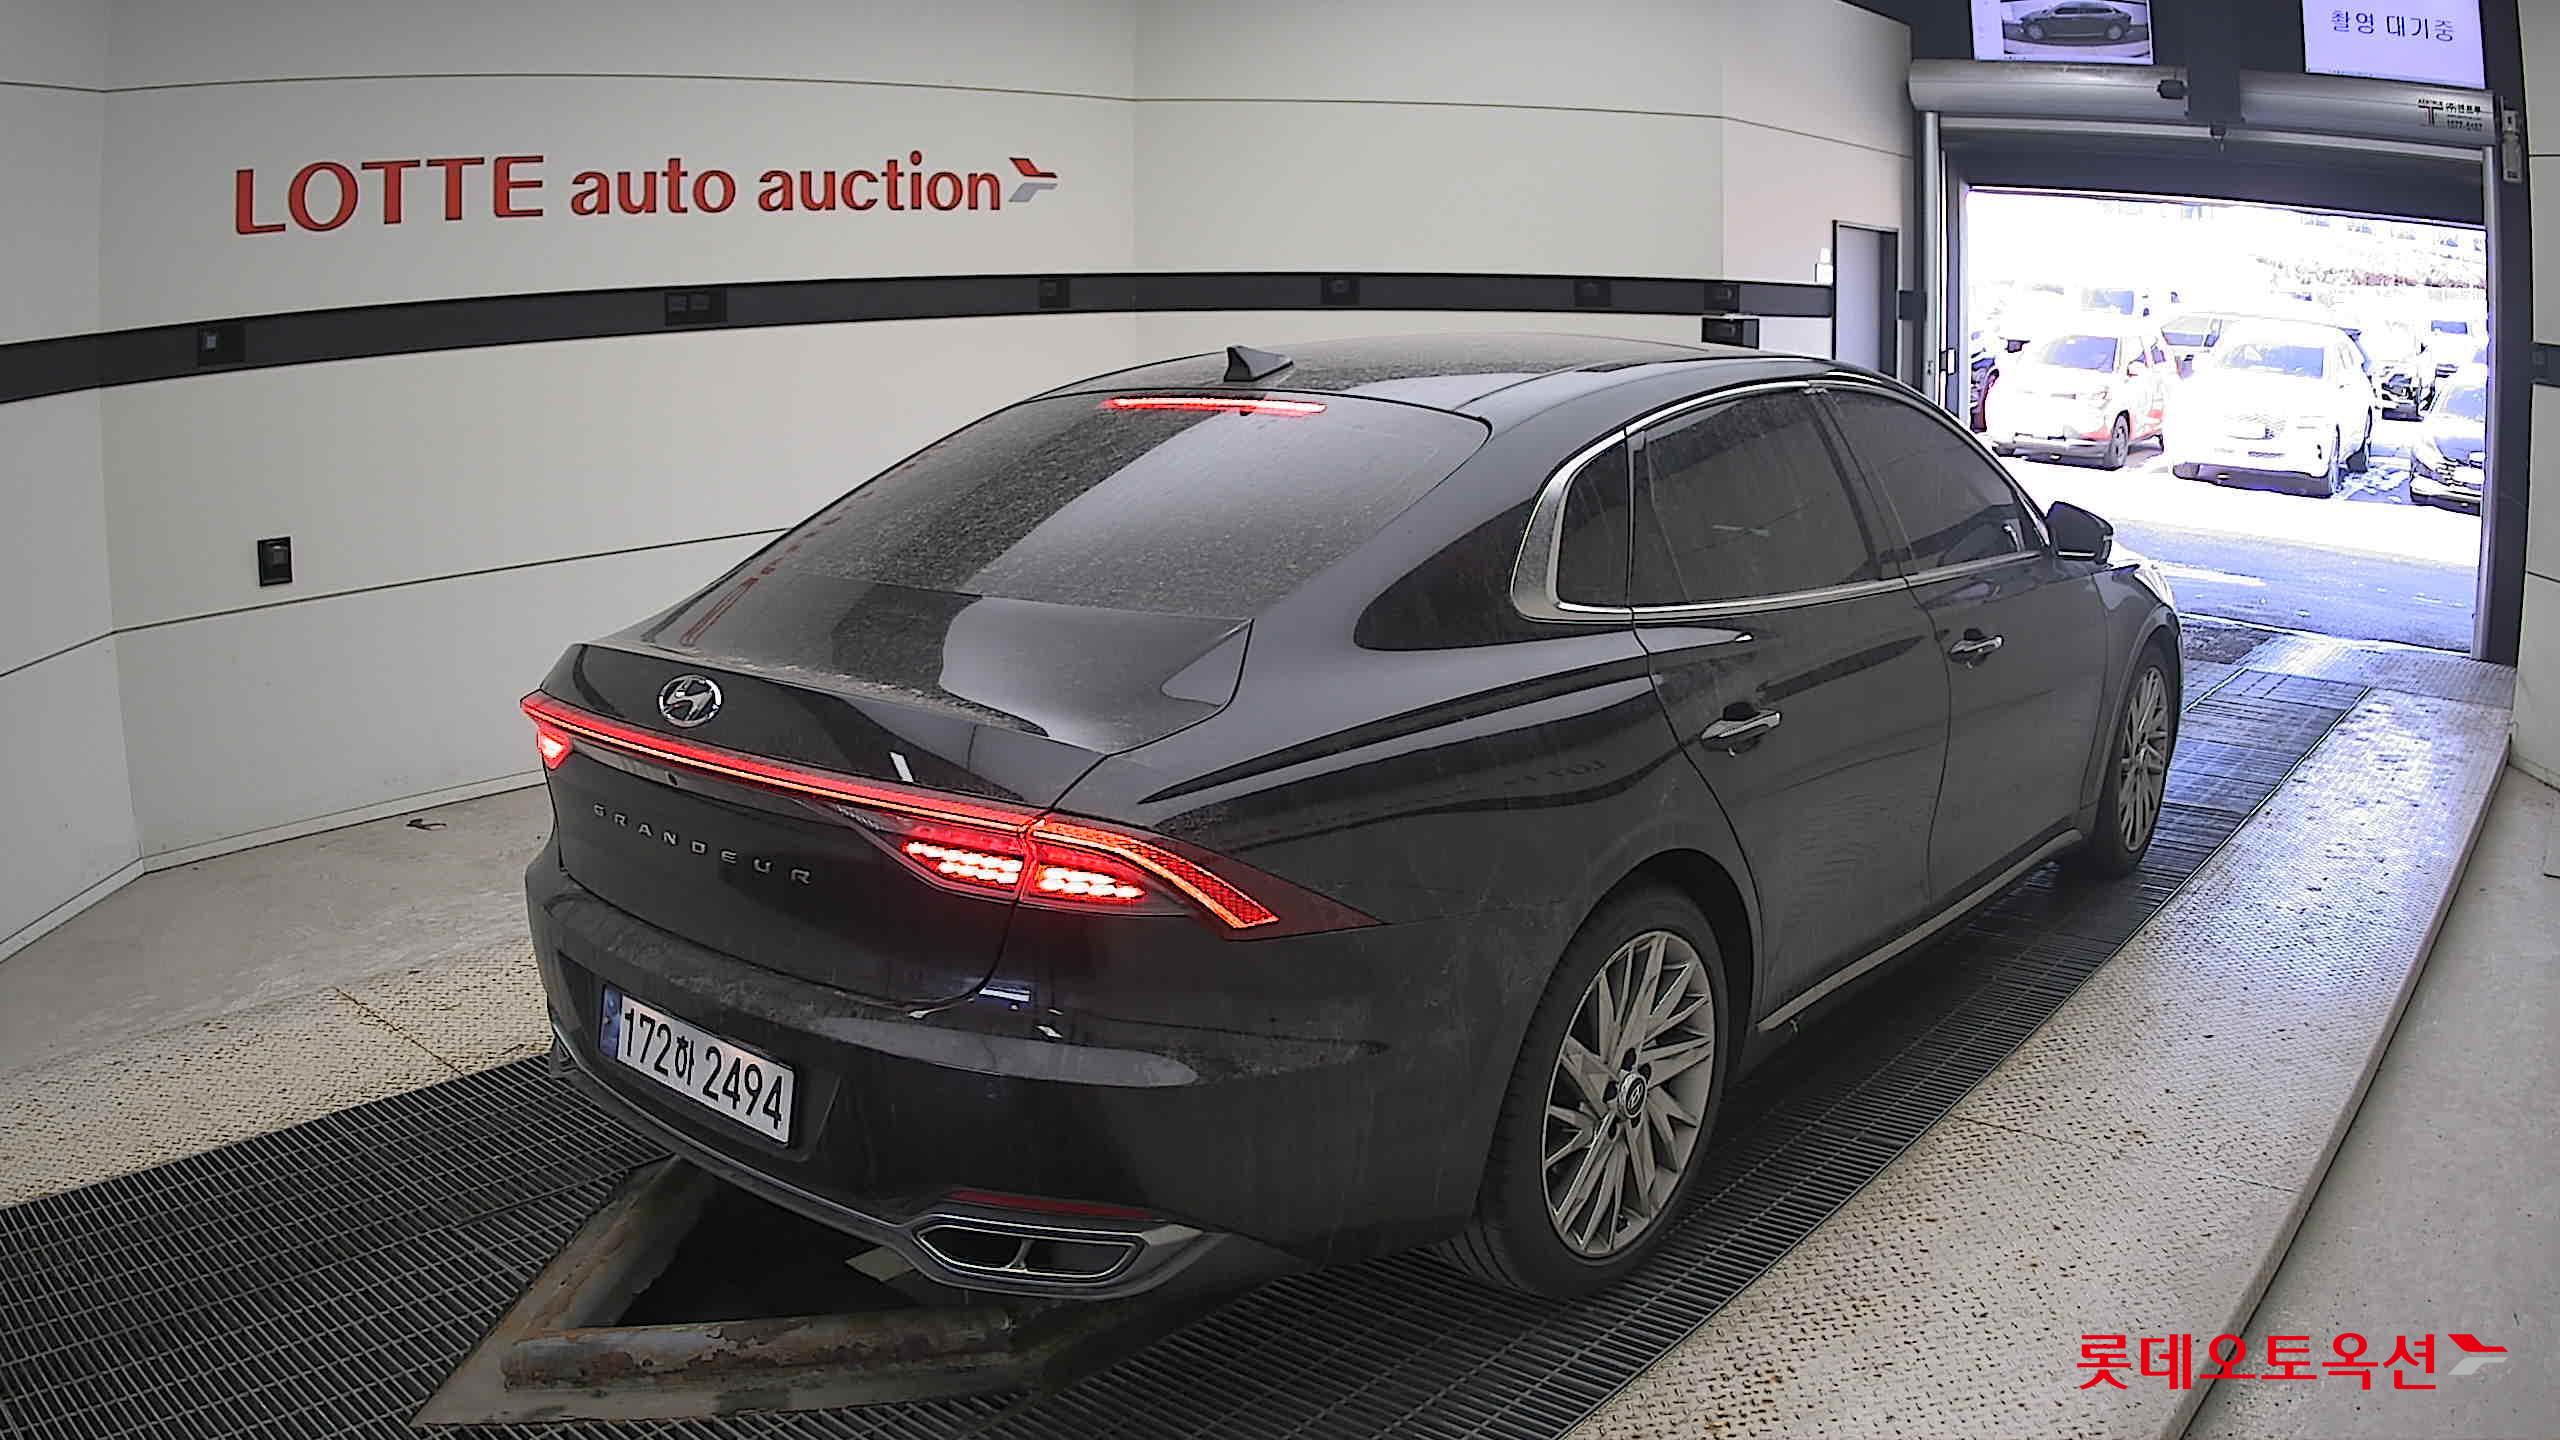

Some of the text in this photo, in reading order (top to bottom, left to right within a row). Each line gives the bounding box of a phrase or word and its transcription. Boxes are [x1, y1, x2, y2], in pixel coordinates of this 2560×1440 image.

[2386, 15, 2454, 42] 대기중
[234, 150, 1001, 235] LOTTE auto auction
[592, 803, 811, 884] GRANDEUR
[702, 1045, 783, 1130] 2494
